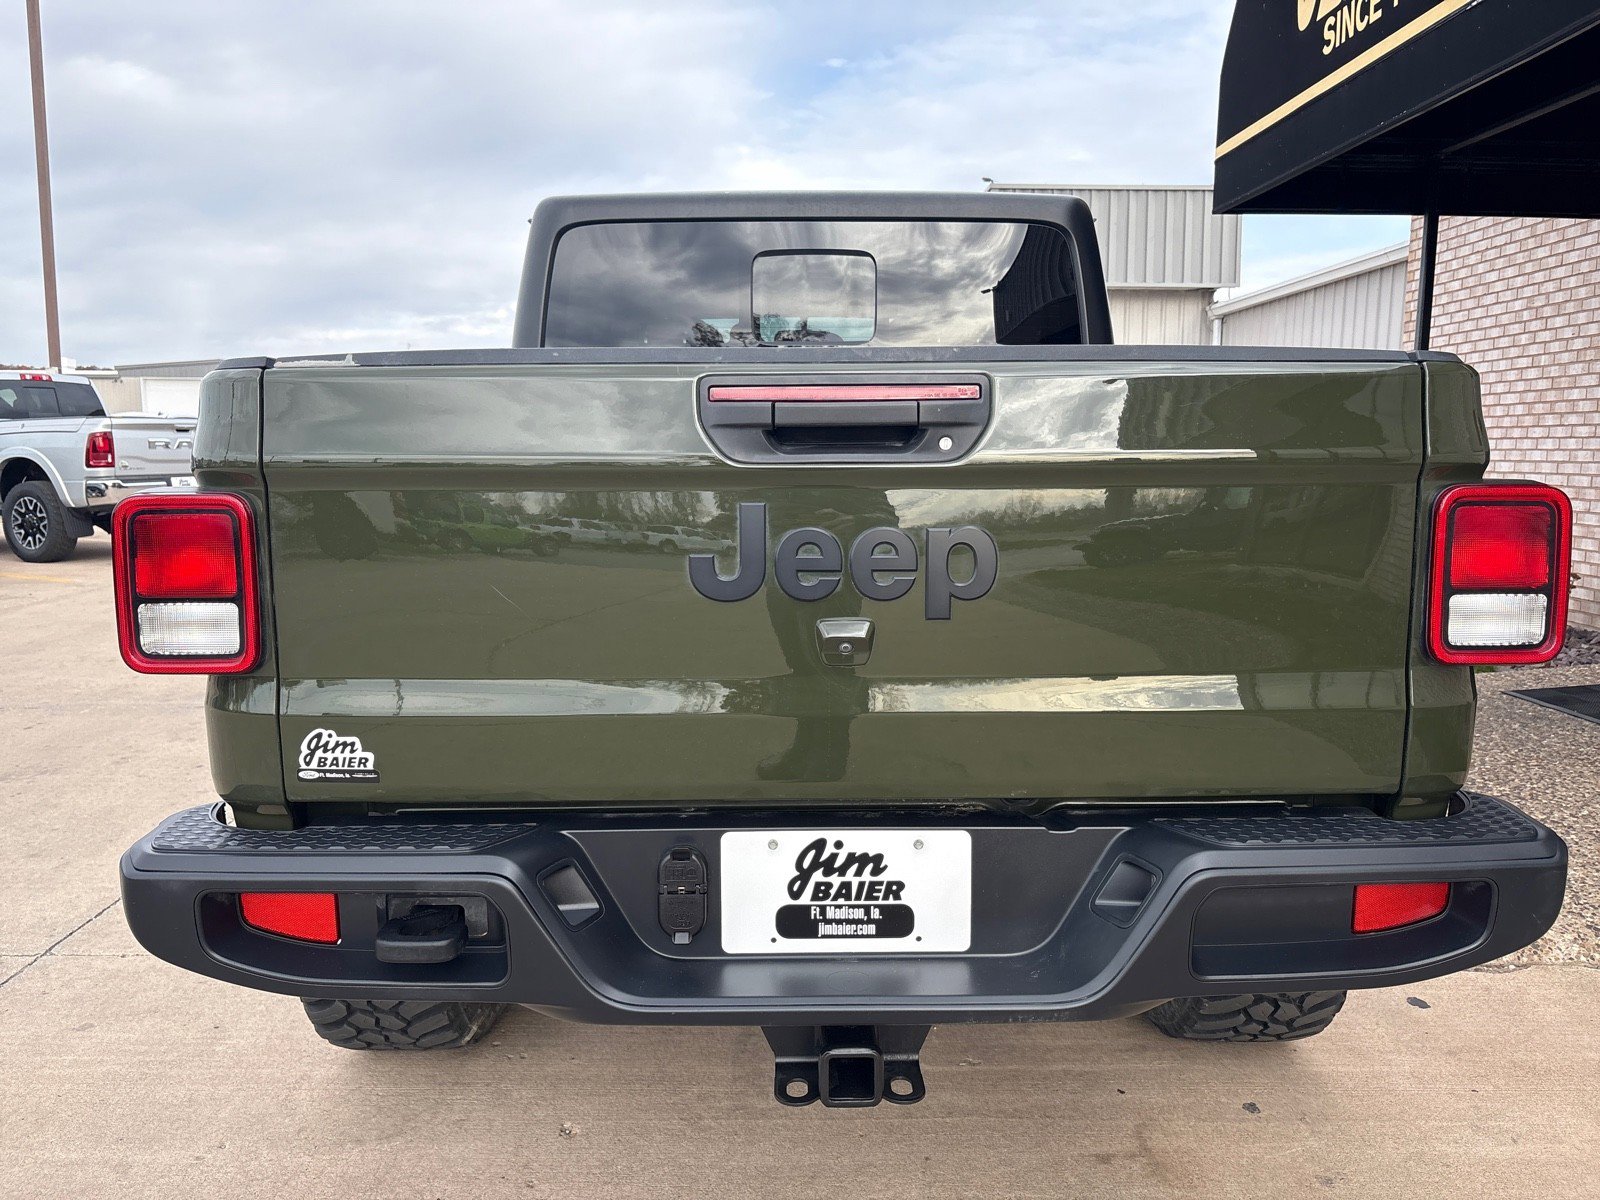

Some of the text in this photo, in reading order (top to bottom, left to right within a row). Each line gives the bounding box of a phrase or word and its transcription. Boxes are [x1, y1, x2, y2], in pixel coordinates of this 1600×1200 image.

[1322, 0, 1383, 55] SINCE
[147, 438, 193, 450] RA
[688, 502, 998, 620] Jeep
[303, 732, 358, 767] Jim
[317, 757, 369, 768] BAIER
[787, 837, 888, 901] Jim
[810, 880, 905, 901] BAIER
[810, 905, 823, 920] Ft.
[826, 905, 868, 921] Madison,
[817, 922, 876, 937] jimbaier.com
